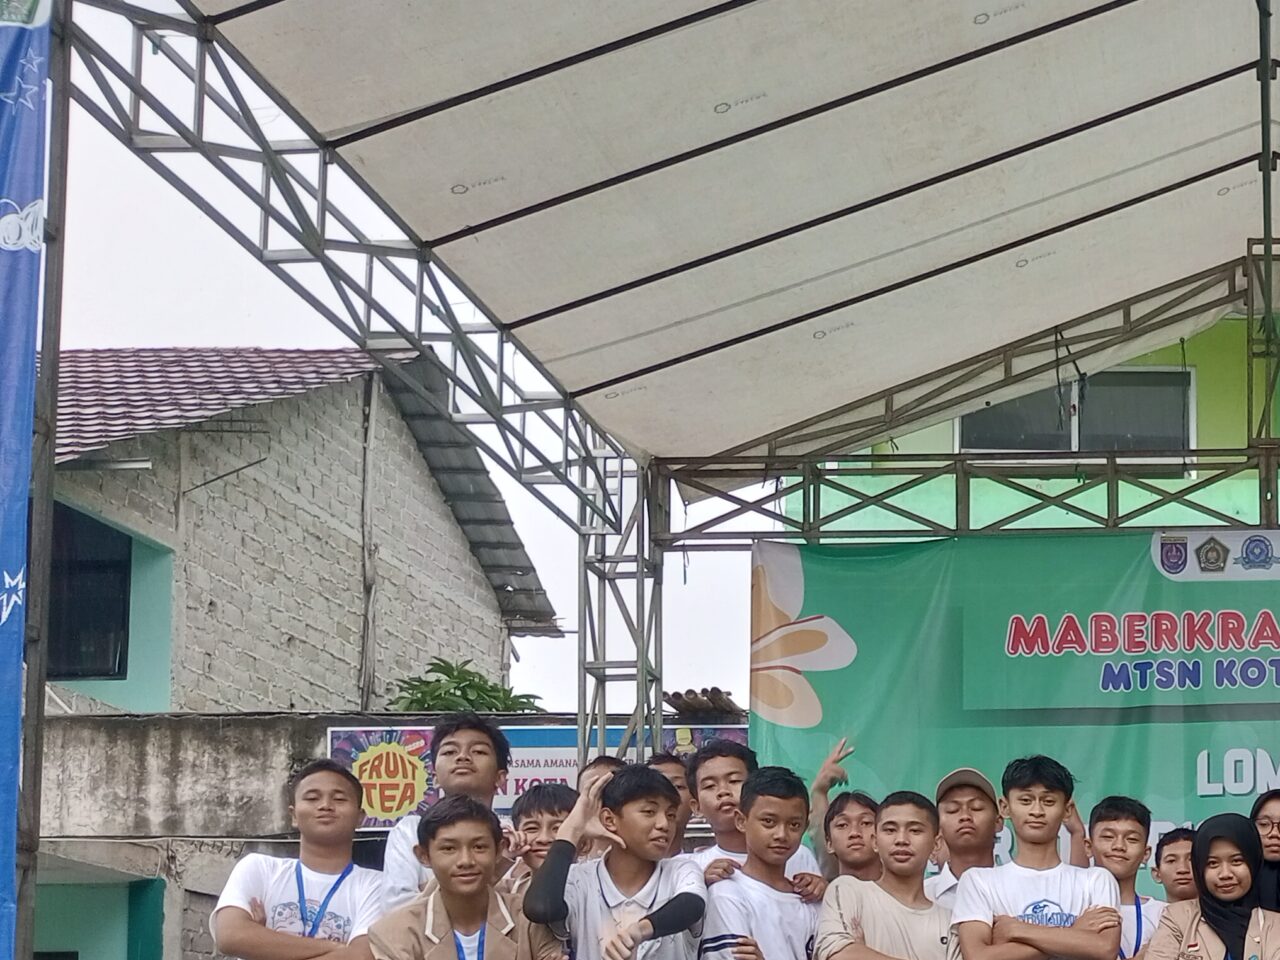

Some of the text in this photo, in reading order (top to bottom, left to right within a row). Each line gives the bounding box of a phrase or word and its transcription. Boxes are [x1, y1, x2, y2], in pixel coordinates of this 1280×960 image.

[1100, 659, 1202, 691] MTSN
[358, 751, 419, 781] FRUIT
[362, 782, 416, 813] TEA
